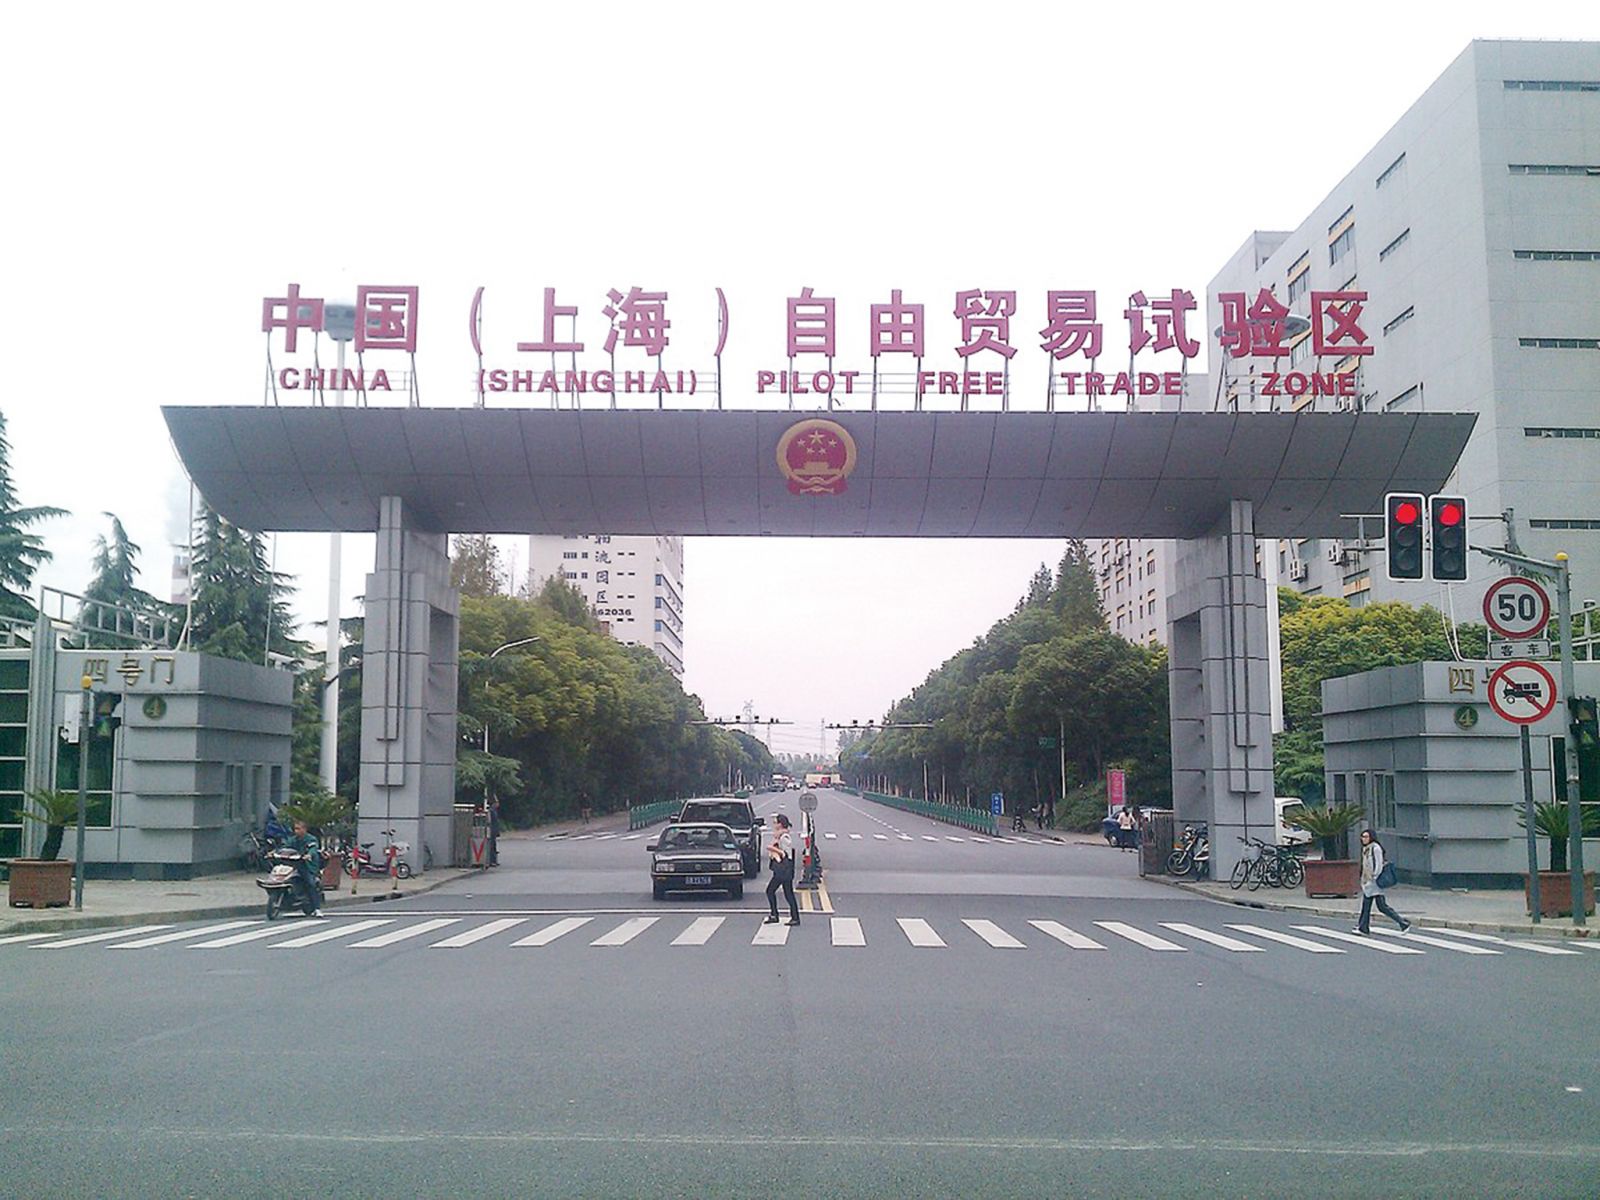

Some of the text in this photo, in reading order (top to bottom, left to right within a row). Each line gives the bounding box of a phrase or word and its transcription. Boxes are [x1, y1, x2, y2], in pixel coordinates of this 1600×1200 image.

[279, 368, 392, 391] CHINA
[757, 370, 860, 394] PILOT
[918, 371, 1004, 395] FREE
[1060, 371, 1185, 396] TRADE
[1260, 371, 1357, 397] ZONE
[1498, 593, 1537, 622] 50
[1500, 643, 1541, 657] 客车
[82, 652, 176, 687] 四号门
